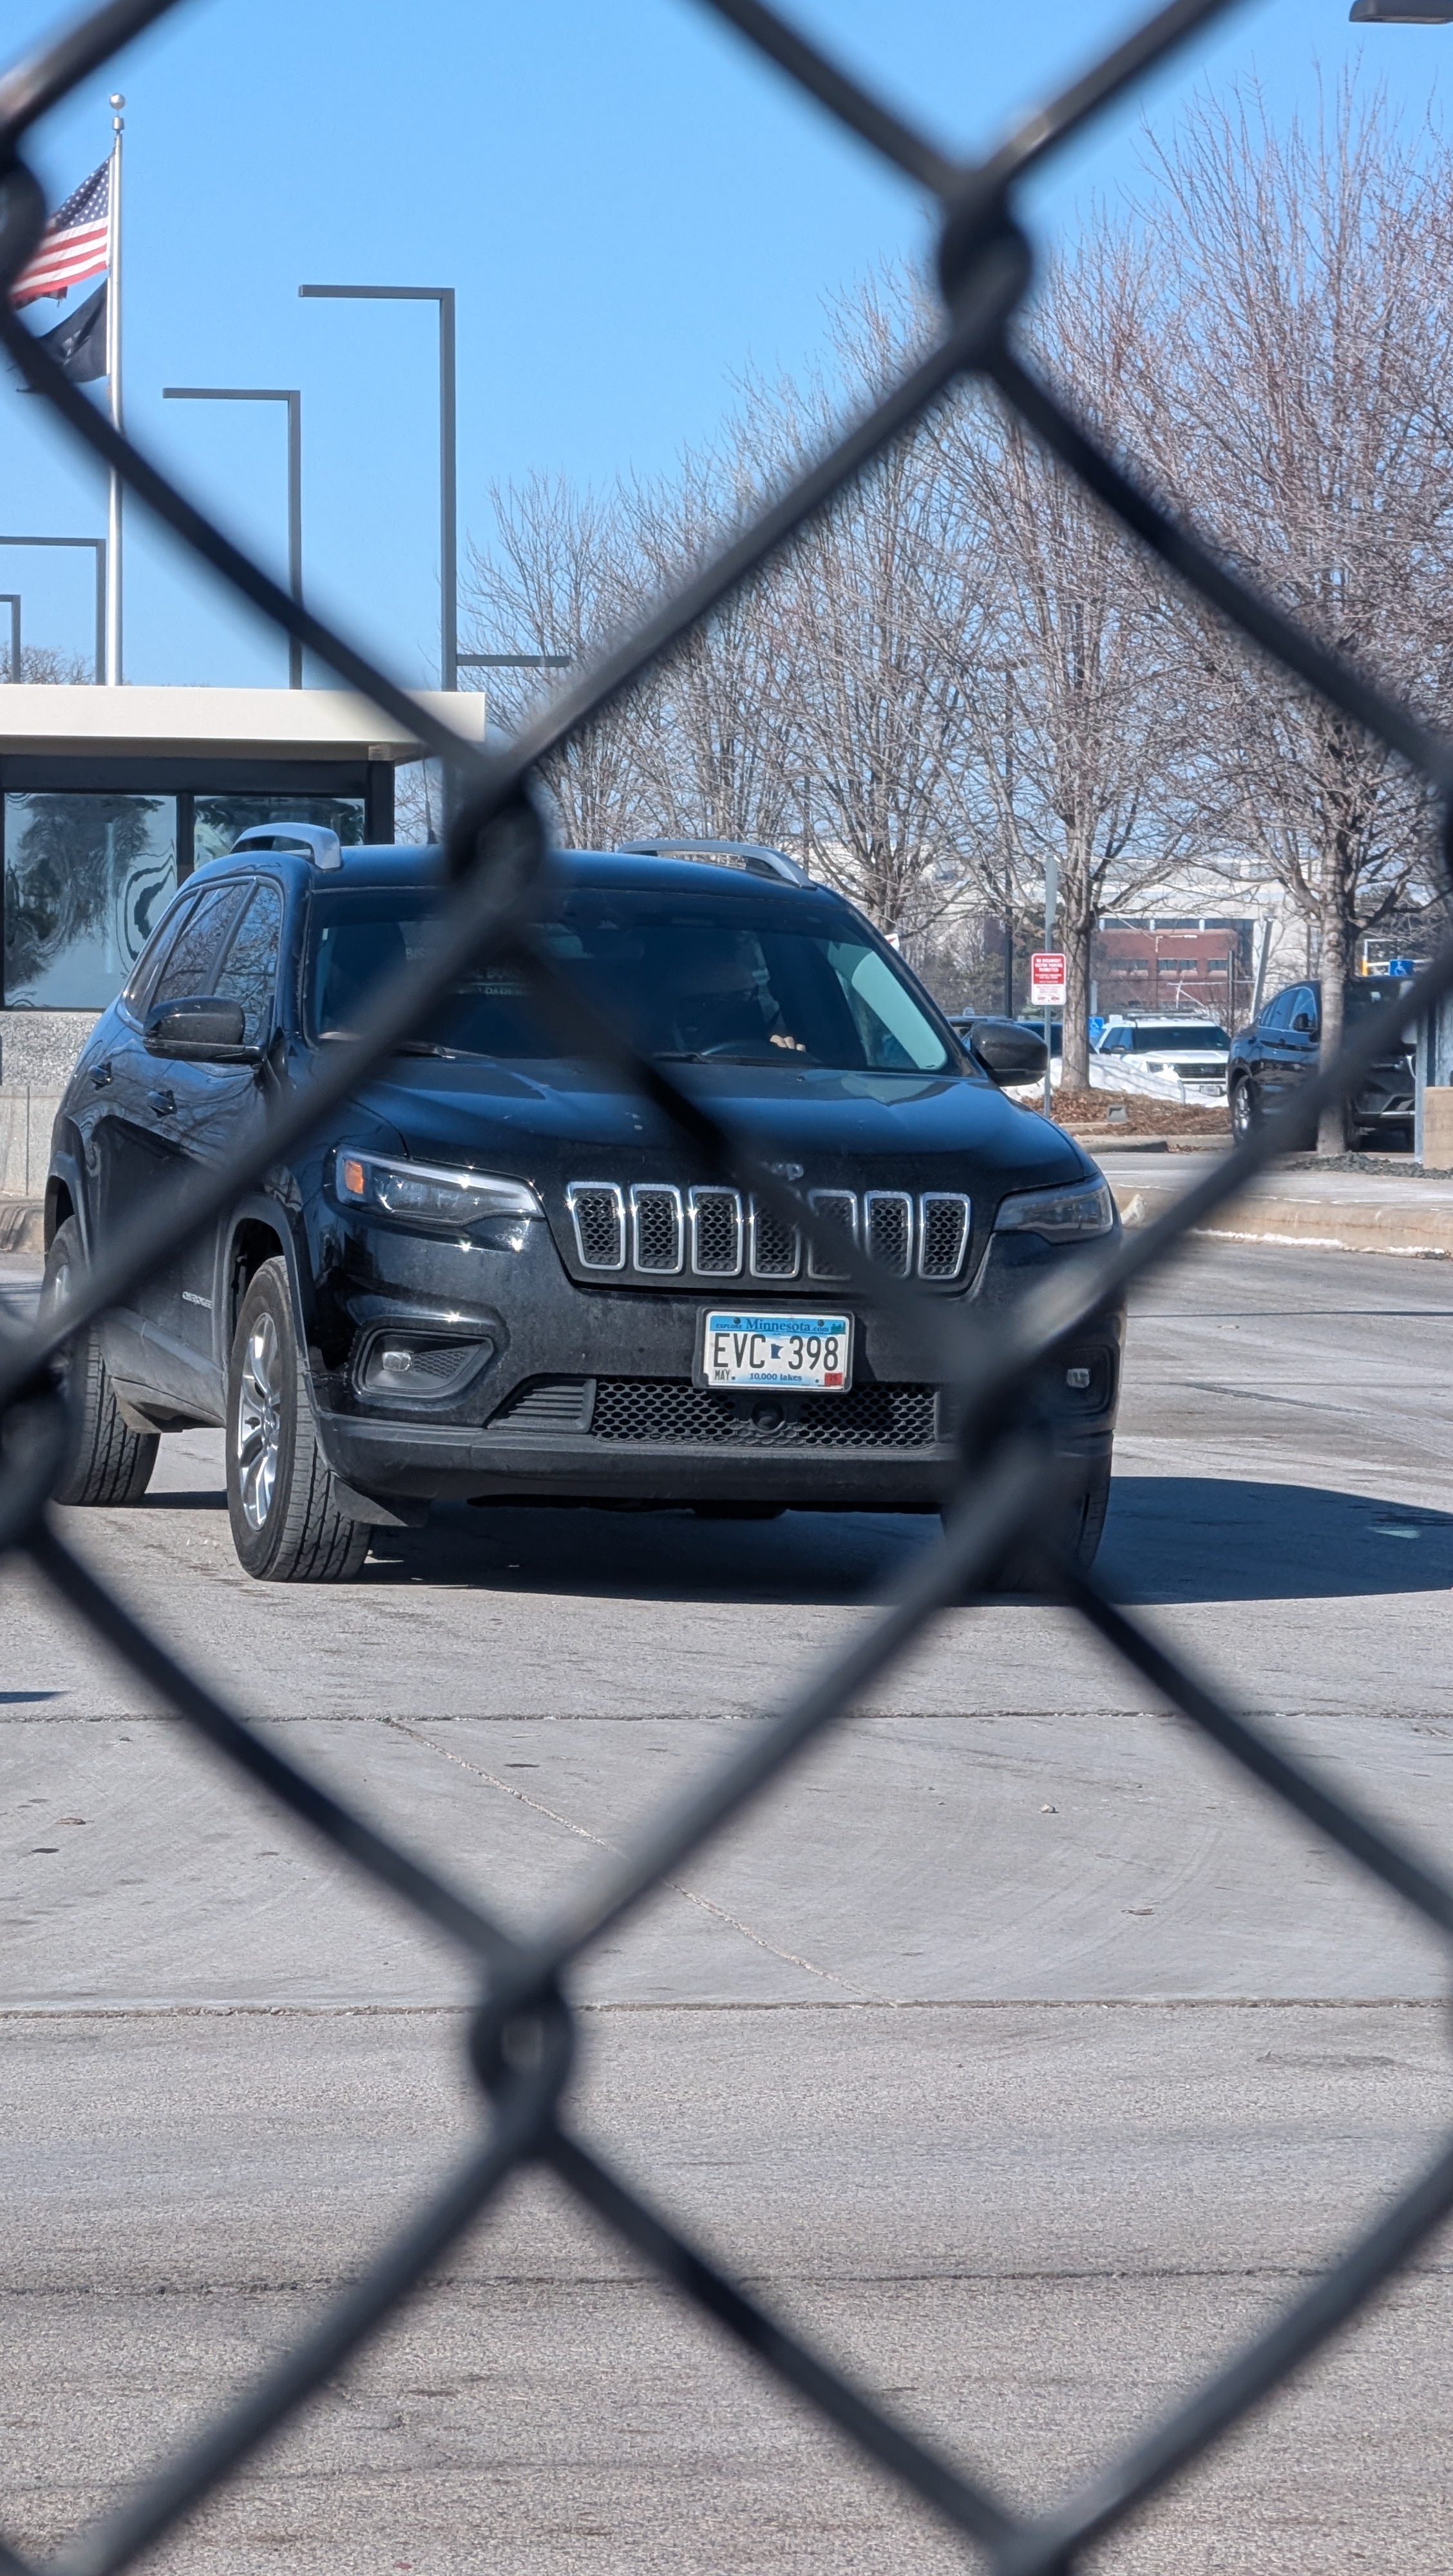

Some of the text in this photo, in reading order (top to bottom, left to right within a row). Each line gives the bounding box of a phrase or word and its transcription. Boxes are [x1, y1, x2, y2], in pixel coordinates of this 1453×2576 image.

[713, 1332, 839, 1371] EVC 398
[714, 1368, 730, 1381] MAY
[749, 1372, 777, 1381] 10,000
